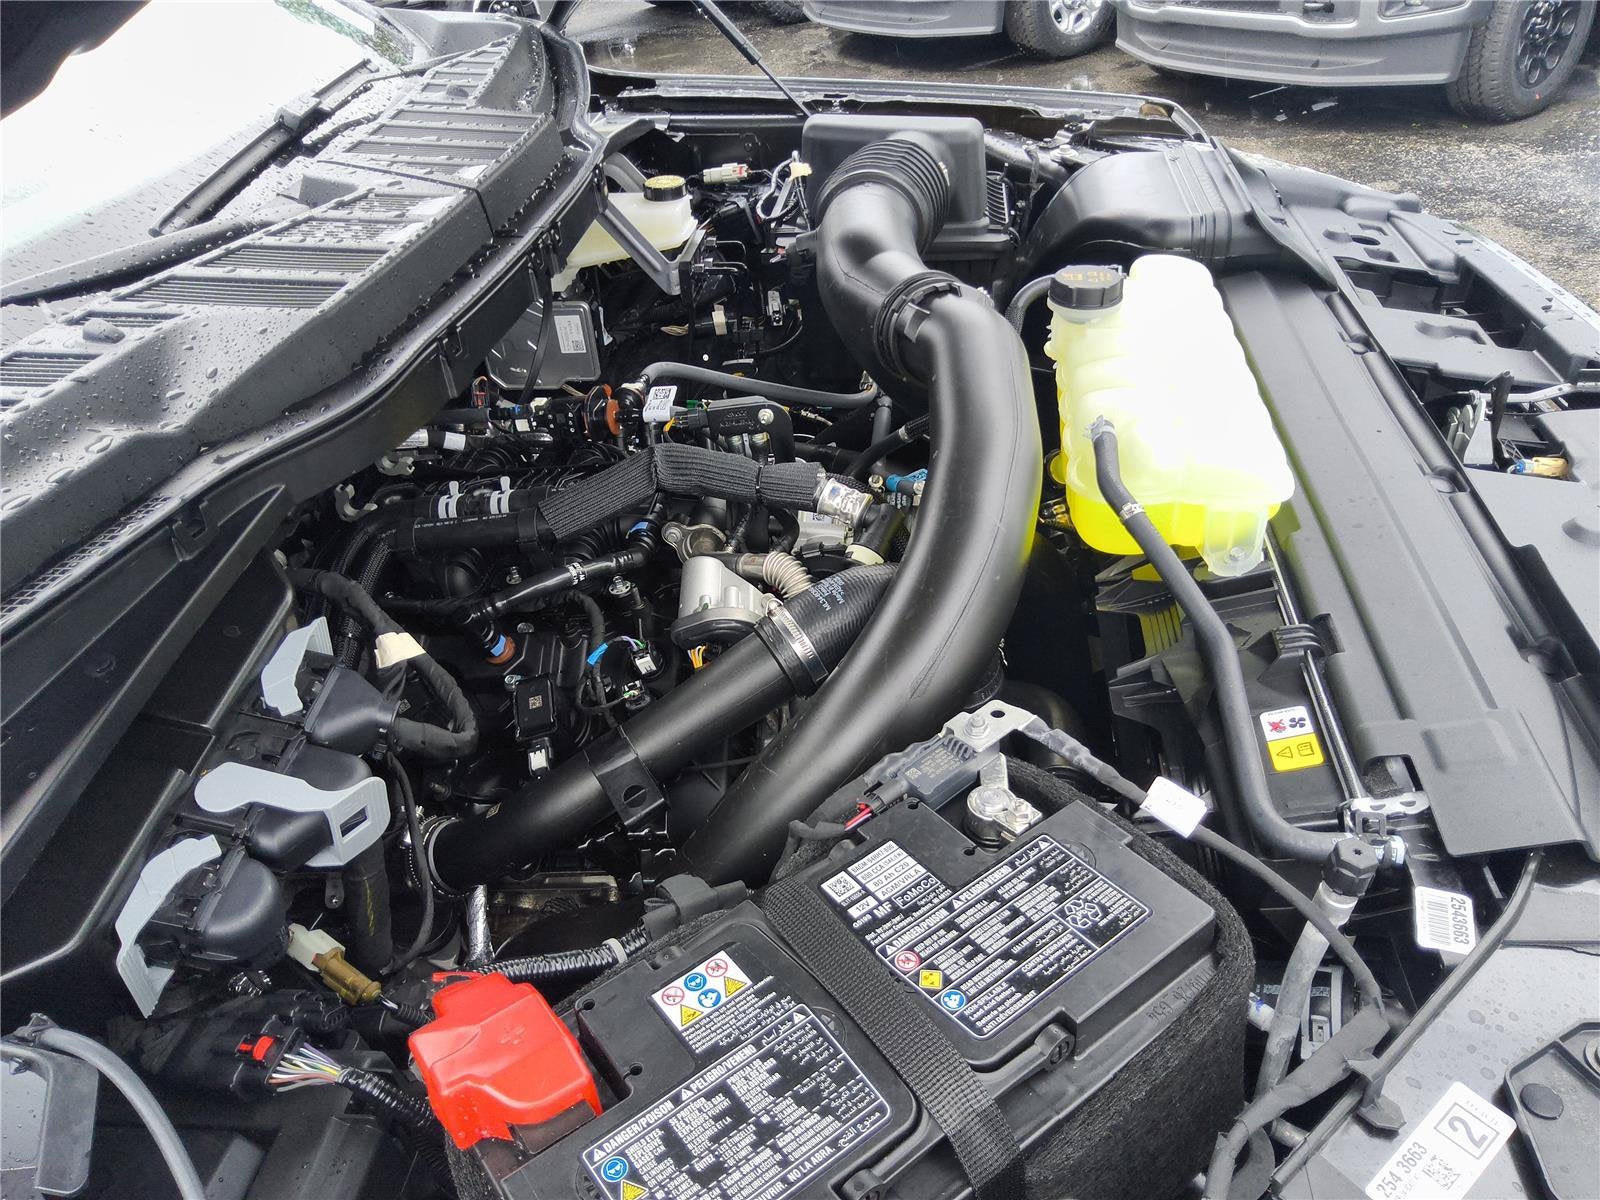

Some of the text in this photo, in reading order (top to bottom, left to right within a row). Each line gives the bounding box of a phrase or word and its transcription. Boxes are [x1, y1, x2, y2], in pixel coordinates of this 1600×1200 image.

[870, 863, 885, 873] CCA
[871, 861, 910, 887] 80 Ah C20
[878, 867, 922, 896] AGM/VRLA
[894, 875, 937, 905] FoMoCo
[854, 899, 872, 912] 12V
[871, 900, 896, 918] MF
[890, 907, 949, 948] DANGER/POISON
[957, 864, 1013, 903] PELIGRO/VENENO
[1074, 907, 1088, 917] Pb
[1449, 896, 1471, 946] 2543663
[1019, 953, 1046, 973] CONTRA
[1042, 933, 1073, 956] DERRAMES
[962, 980, 1009, 1015] NON-SPILLABLE
[968, 1007, 985, 1020] Lead
[981, 999, 997, 1010] Acid
[725, 1057, 762, 1085] PROTEJA LOS
[746, 1068, 759, 1080] LOS
[756, 1056, 777, 1073] GASES
[734, 1070, 770, 1097] EXPLOSIVOS
[740, 1071, 782, 1102] PUEDEN CAUSAR
[602, 1042, 757, 1153] DANGER/POISON PELIGRO/VENENO
[759, 1095, 794, 1123] NO CHISPAS
[668, 1115, 679, 1126] SE
[672, 1119, 686, 1132] LES
[700, 1100, 713, 1112] LES
[710, 1092, 725, 1105] GAZ
[677, 1097, 732, 1138] EXPLOSIFS PEUVENT
[715, 1120, 725, 1130] ET
[721, 1114, 732, 1125] LA
[776, 1102, 798, 1120] FLAMAS
[781, 1105, 808, 1126] CIGARROS
[624, 1126, 664, 1156] SHIELD EYES,
[681, 1118, 715, 1144] CAUSER DES
[781, 1139, 799, 1154] PUEDE
[795, 1127, 816, 1144] CAUSAR
[1448, 1114, 1490, 1151] 2
[629, 1136, 662, 1162] EXPLOSIVE
[633, 1143, 666, 1169] GASES CAN
[717, 1142, 729, 1153] LES
[721, 1132, 757, 1160] LES FLAMMES
[726, 1144, 753, 1166] DE FUMER
[637, 1158, 658, 1175] CAUSE
[641, 1156, 674, 1182] BLINDNESS
[646, 1162, 679, 1188] OR INJURY.
[785, 1142, 837, 1183] NO LA ABRA.
[1375, 1166, 1404, 1199] 254
[1401, 1140, 1429, 1177] 3663
[666, 1171, 689, 1191] SPARKS
[670, 1177, 694, 1196] FLAMES
[719, 1168, 743, 1189] L'ACIDE
[726, 1183, 740, 1196] PEUT
[736, 1171, 758, 1189] CAUSER
[753, 1167, 762, 1176] LA
[654, 1188, 666, 1200] NO
